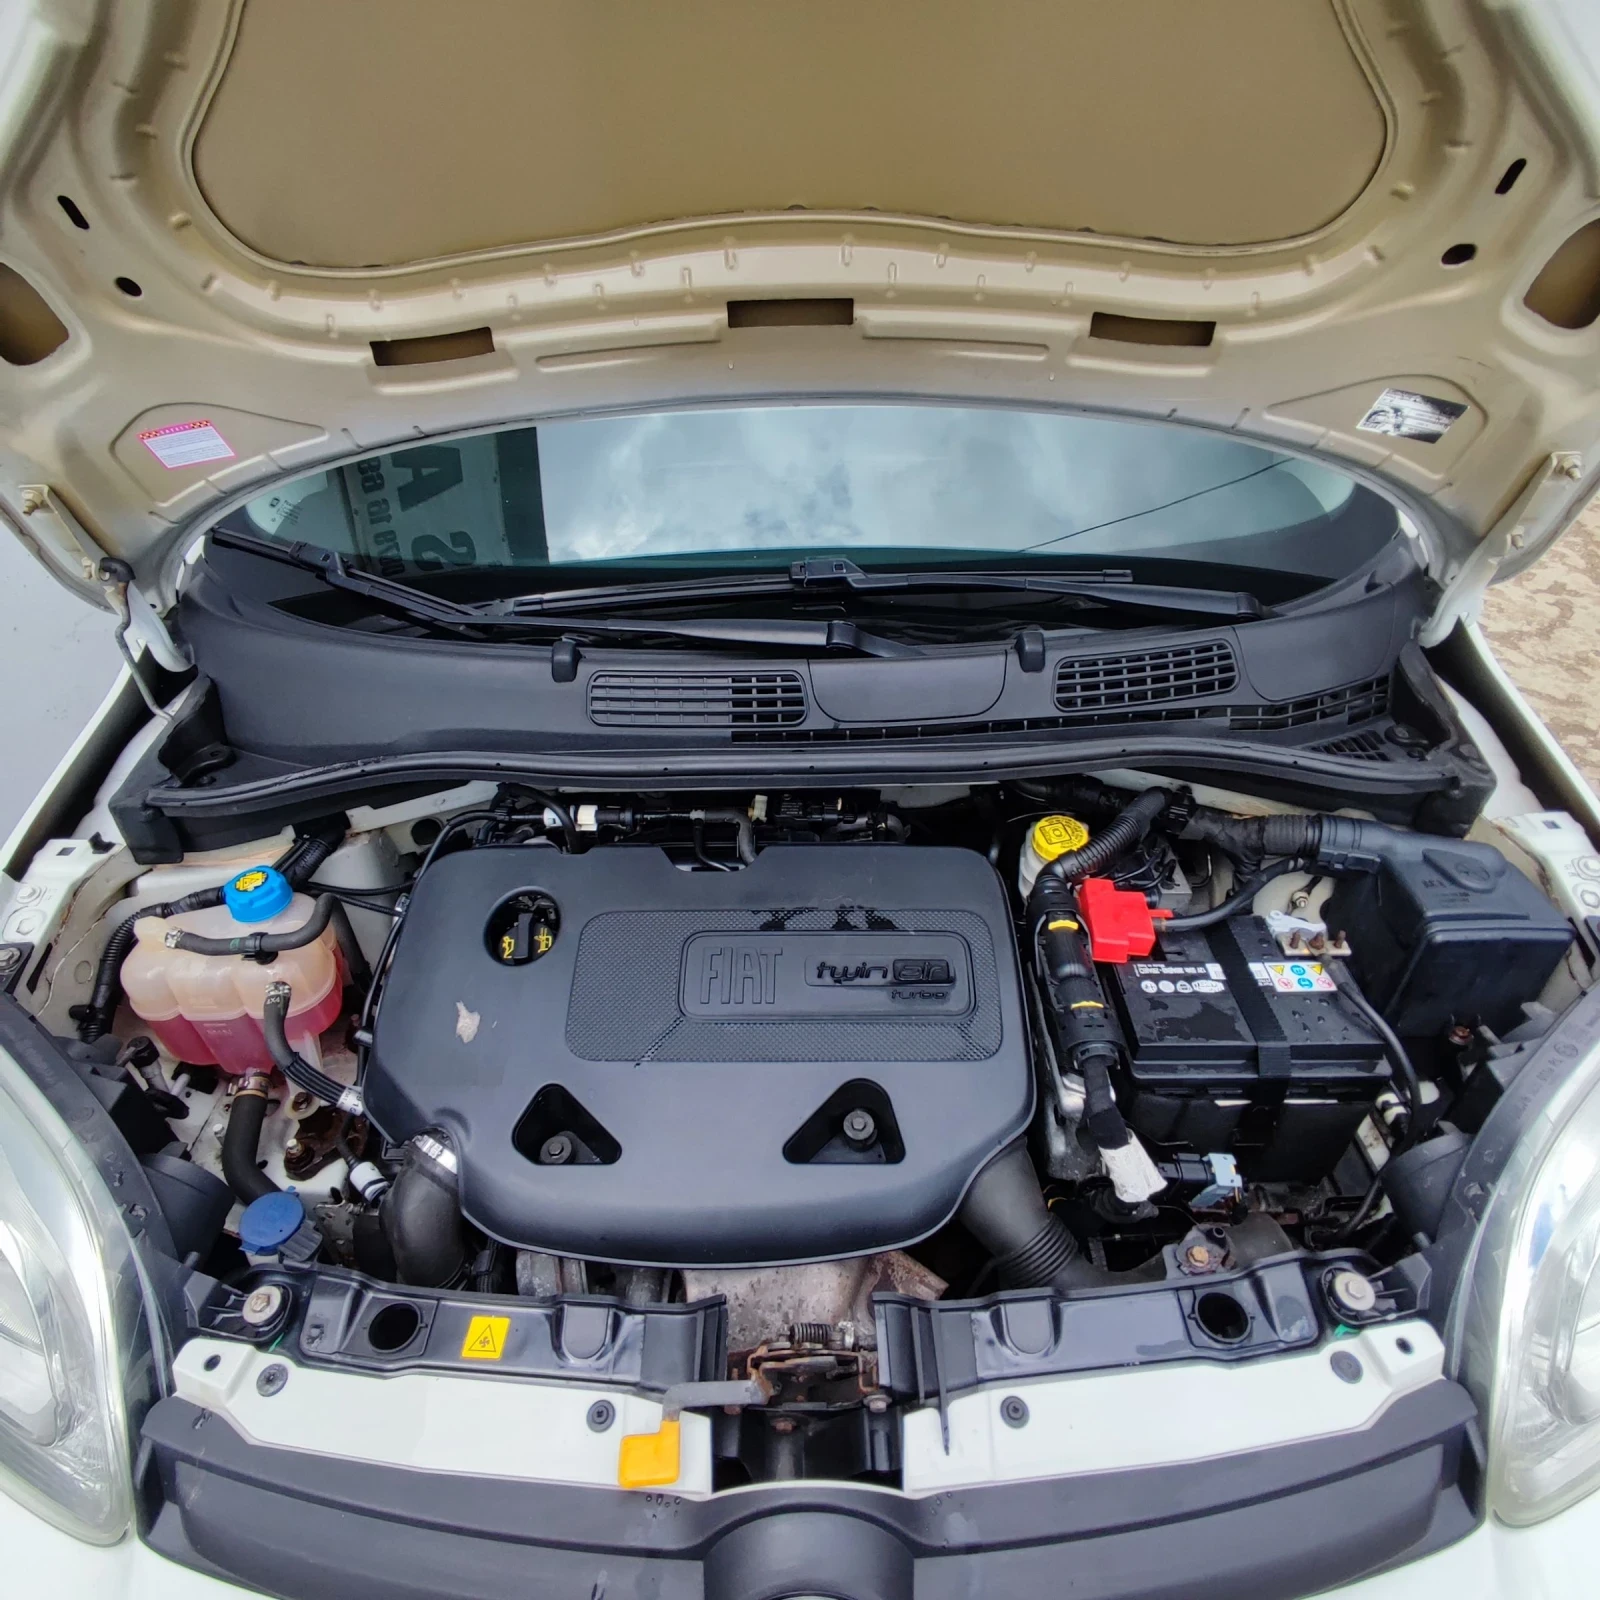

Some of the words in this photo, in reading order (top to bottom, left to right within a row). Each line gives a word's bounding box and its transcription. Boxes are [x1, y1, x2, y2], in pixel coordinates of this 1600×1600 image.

[699, 947, 783, 1005] FIAT
[816, 961, 888, 979] twin
[900, 961, 944, 981] air
[891, 989, 948, 1000] turbo
